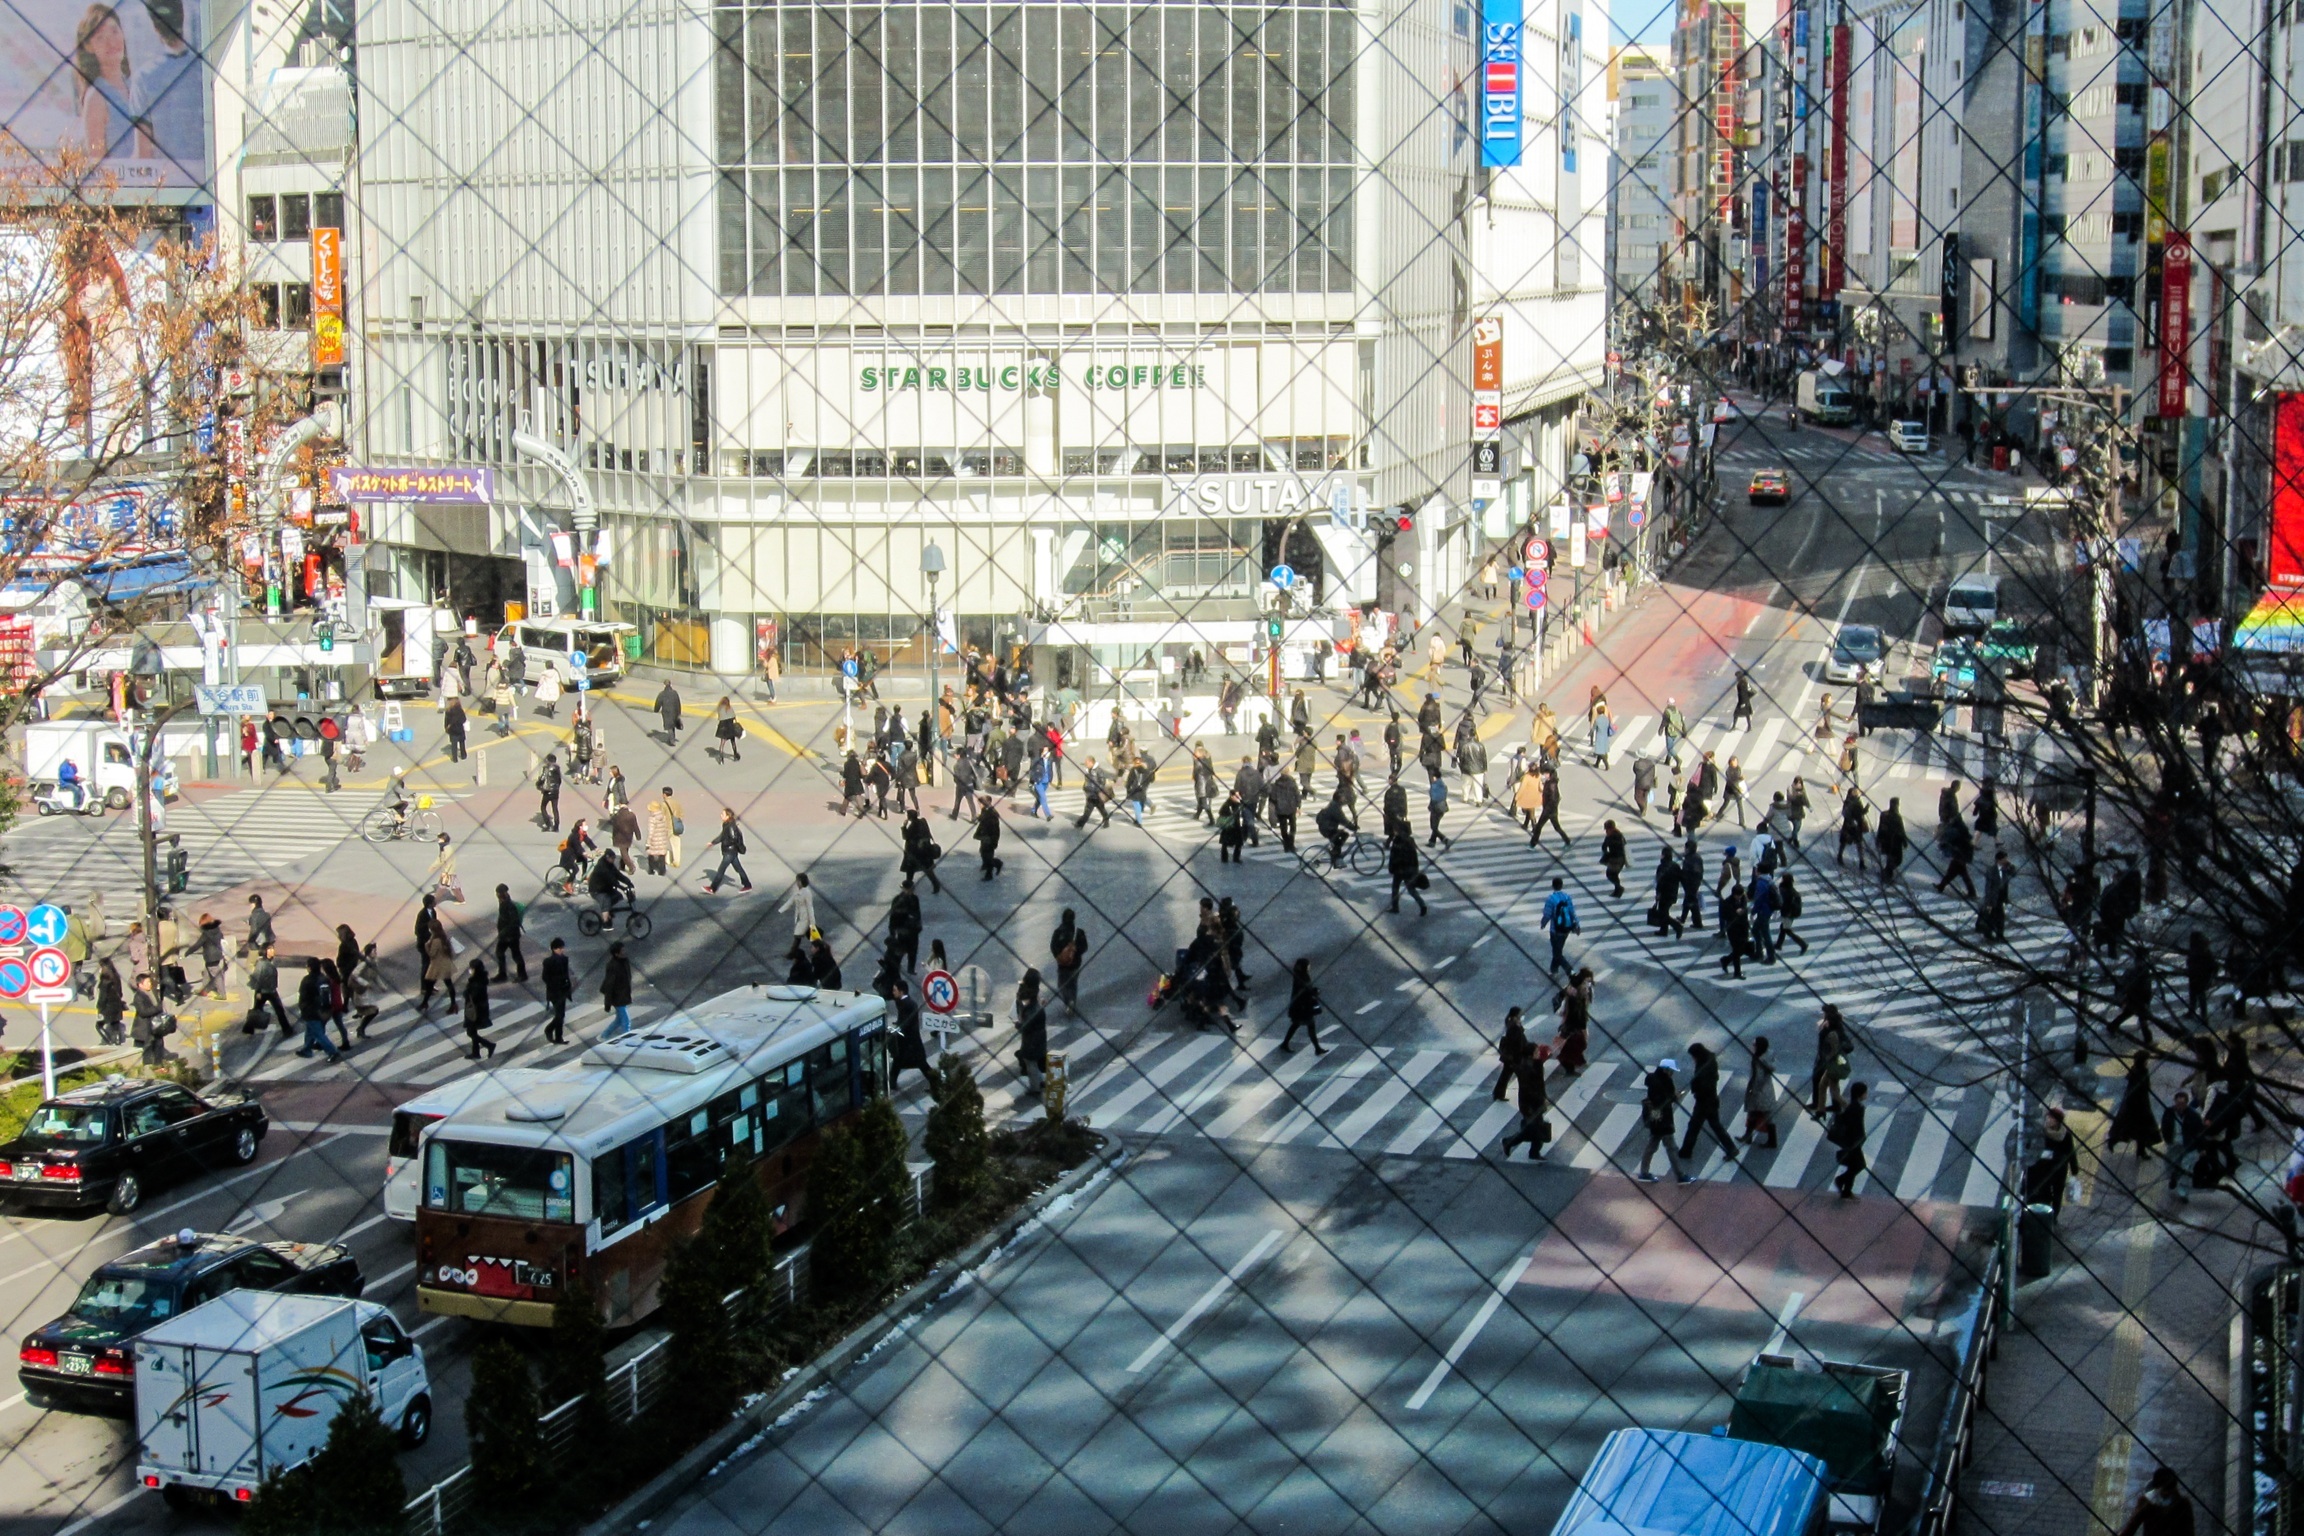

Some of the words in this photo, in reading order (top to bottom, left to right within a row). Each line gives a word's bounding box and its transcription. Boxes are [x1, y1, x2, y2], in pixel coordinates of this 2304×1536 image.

[1486, 22, 1516, 142] SEIBU
[860, 365, 1061, 390] STARBUCKS
[1084, 365, 1206, 390] COFFEE
[1477, 407, 1497, 425] 本
[203, 689, 259, 702] 渋谷駅前
[925, 1018, 957, 1031] ここから
